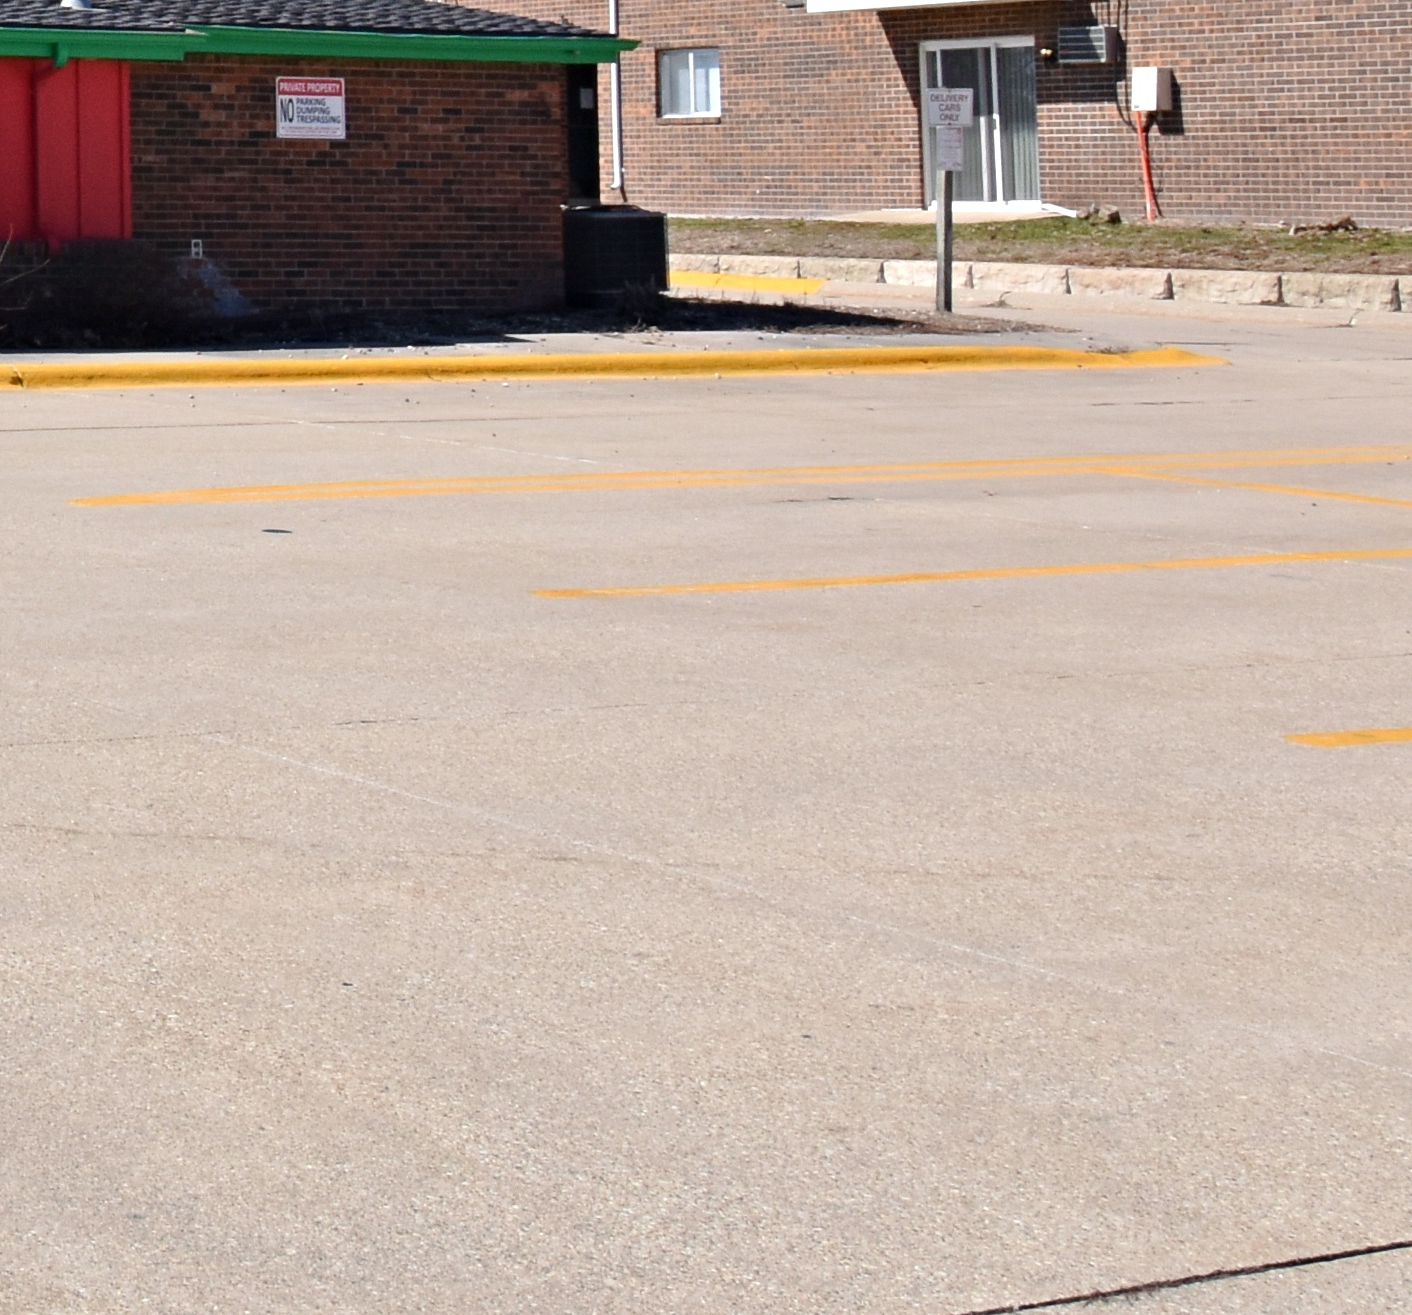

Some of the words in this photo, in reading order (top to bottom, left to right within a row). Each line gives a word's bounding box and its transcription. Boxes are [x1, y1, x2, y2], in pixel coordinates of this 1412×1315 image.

[279, 82, 306, 92] PRIVATE
[307, 83, 340, 93] PROPERTY
[930, 94, 968, 102] DELIVERY
[280, 98, 294, 123] NO
[296, 98, 326, 106] PARKING
[296, 106, 330, 115] DUMPING
[938, 104, 961, 112] CARS
[296, 115, 341, 124] TRESPASSING
[939, 113, 960, 122] ONLY
